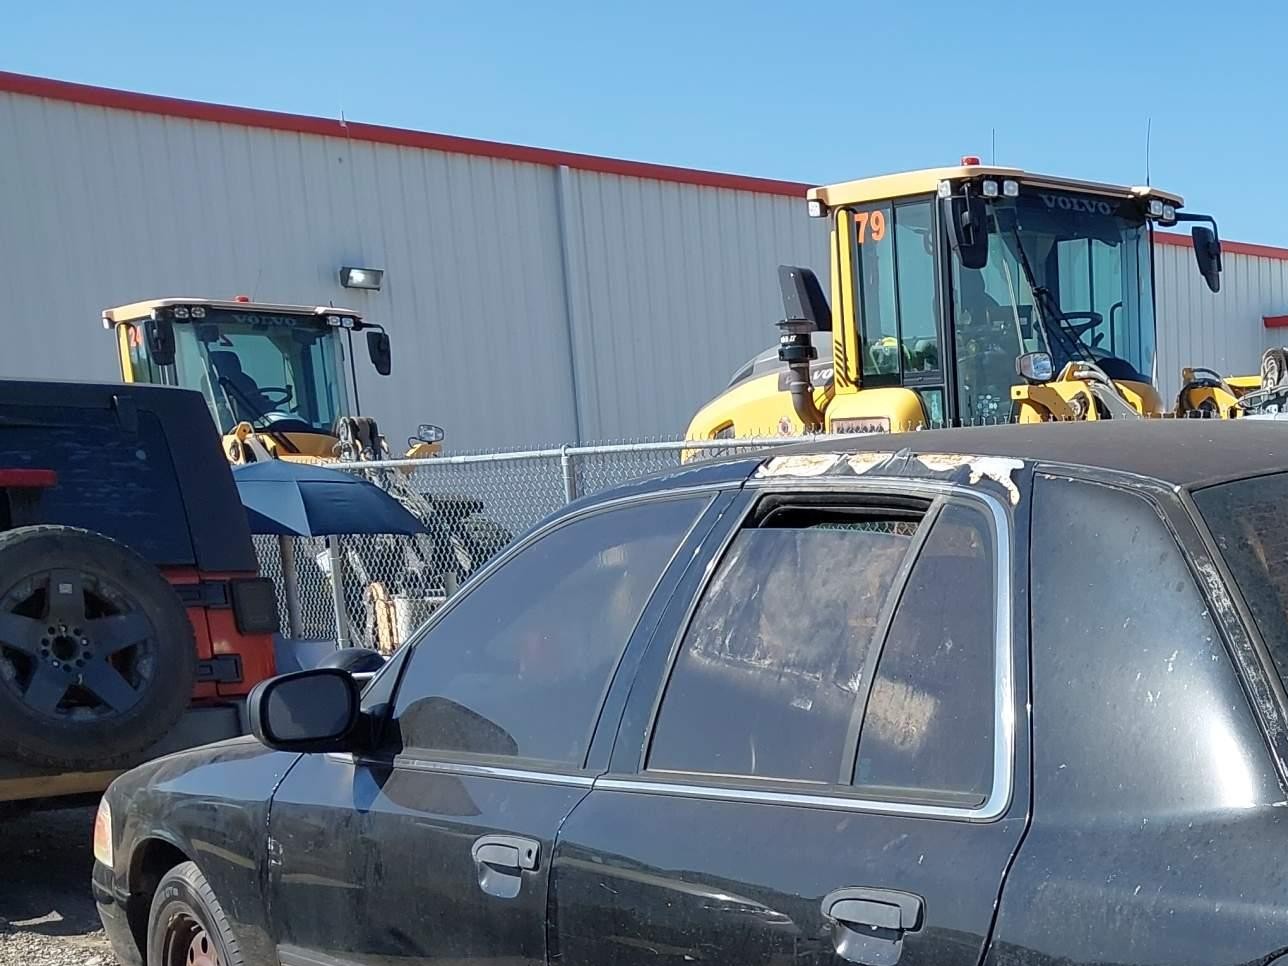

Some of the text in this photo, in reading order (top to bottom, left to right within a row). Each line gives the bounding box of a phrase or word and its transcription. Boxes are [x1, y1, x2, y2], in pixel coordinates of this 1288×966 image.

[1038, 193, 1112, 216] VOLVO
[853, 210, 886, 244] 79
[232, 313, 297, 327] VOLVO
